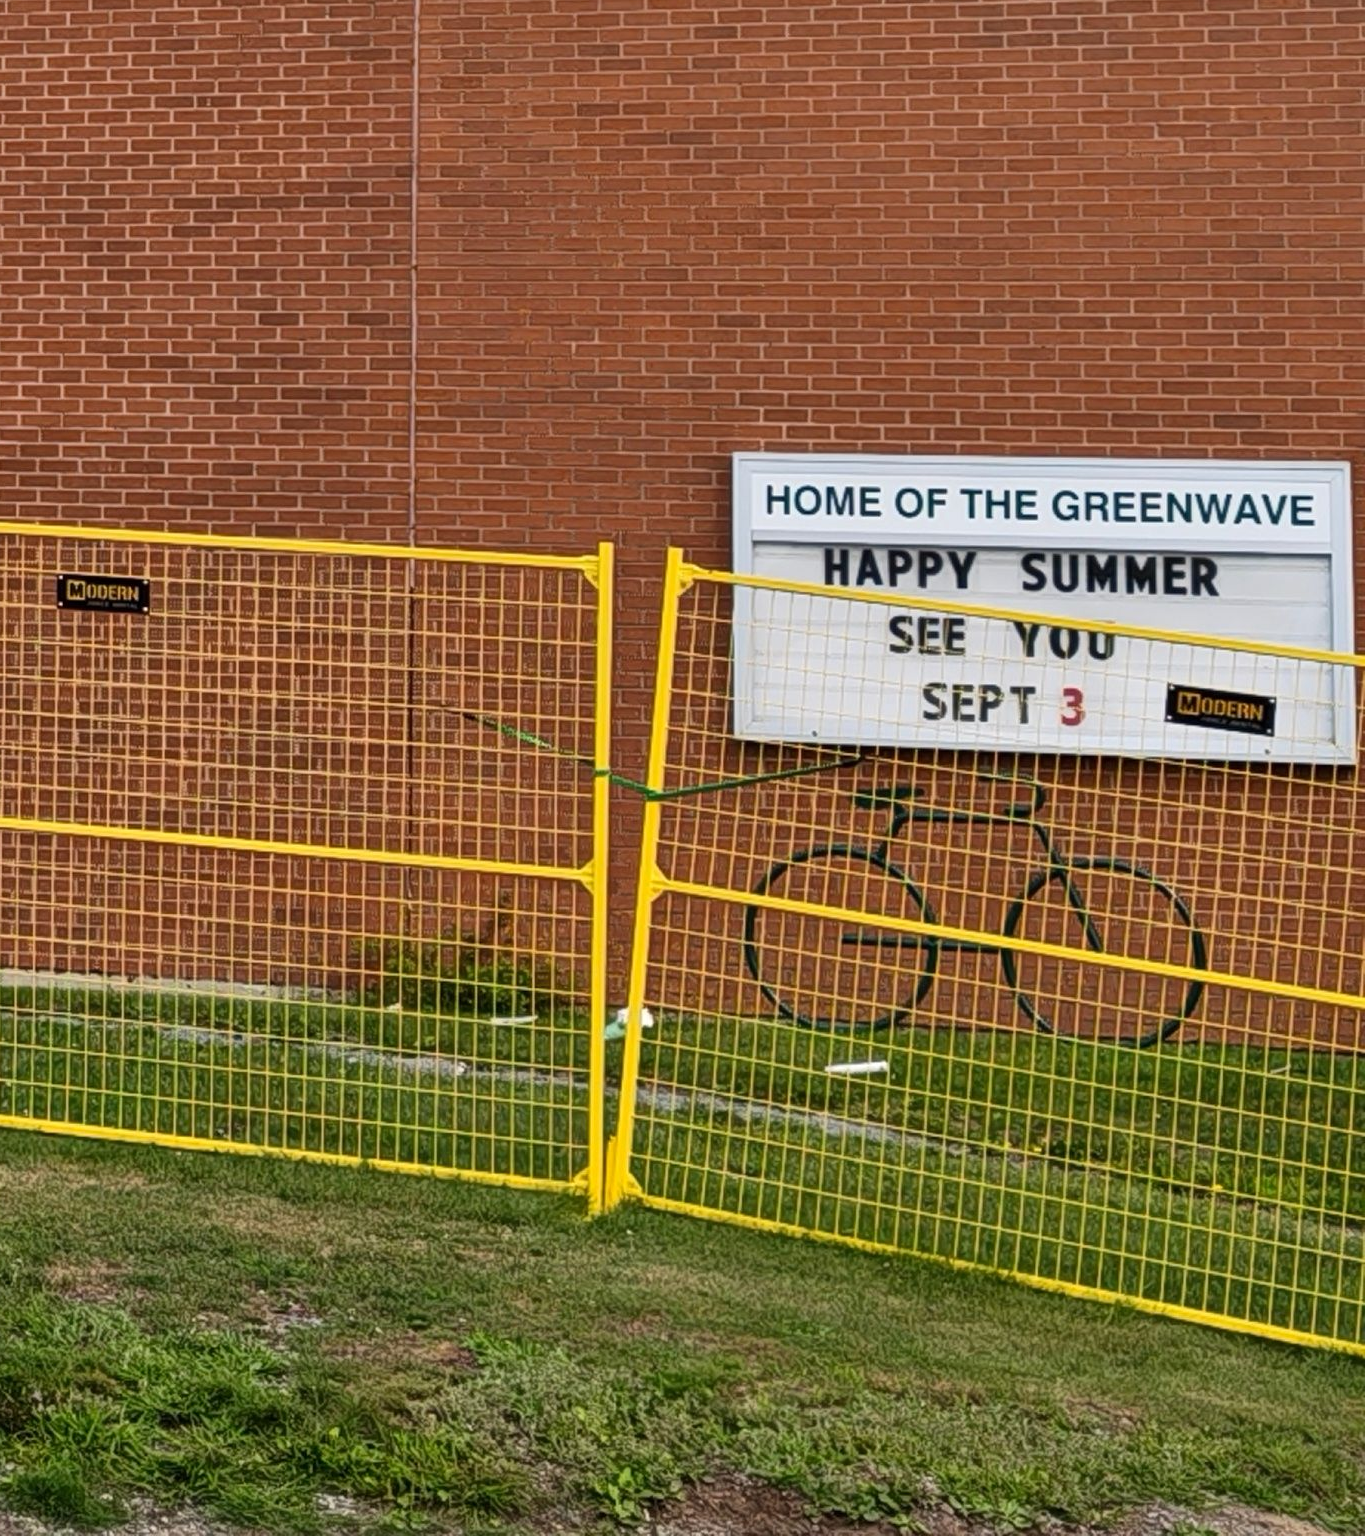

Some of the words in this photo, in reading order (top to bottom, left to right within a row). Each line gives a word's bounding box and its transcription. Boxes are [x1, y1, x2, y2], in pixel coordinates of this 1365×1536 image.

[766, 484, 882, 518] HOME
[894, 487, 948, 518] OF
[960, 489, 1039, 520] THE
[1051, 490, 1316, 527] GREENWAVE
[66, 580, 140, 602] MODERN
[823, 548, 977, 589] HAPPY
[1020, 552, 1220, 597] SUMMER
[888, 615, 967, 656] SEE
[1013, 621, 1117, 660] YOU
[922, 682, 1036, 725] SEPT
[1060, 687, 1086, 726] 3
[1177, 691, 1265, 721] MODERN
